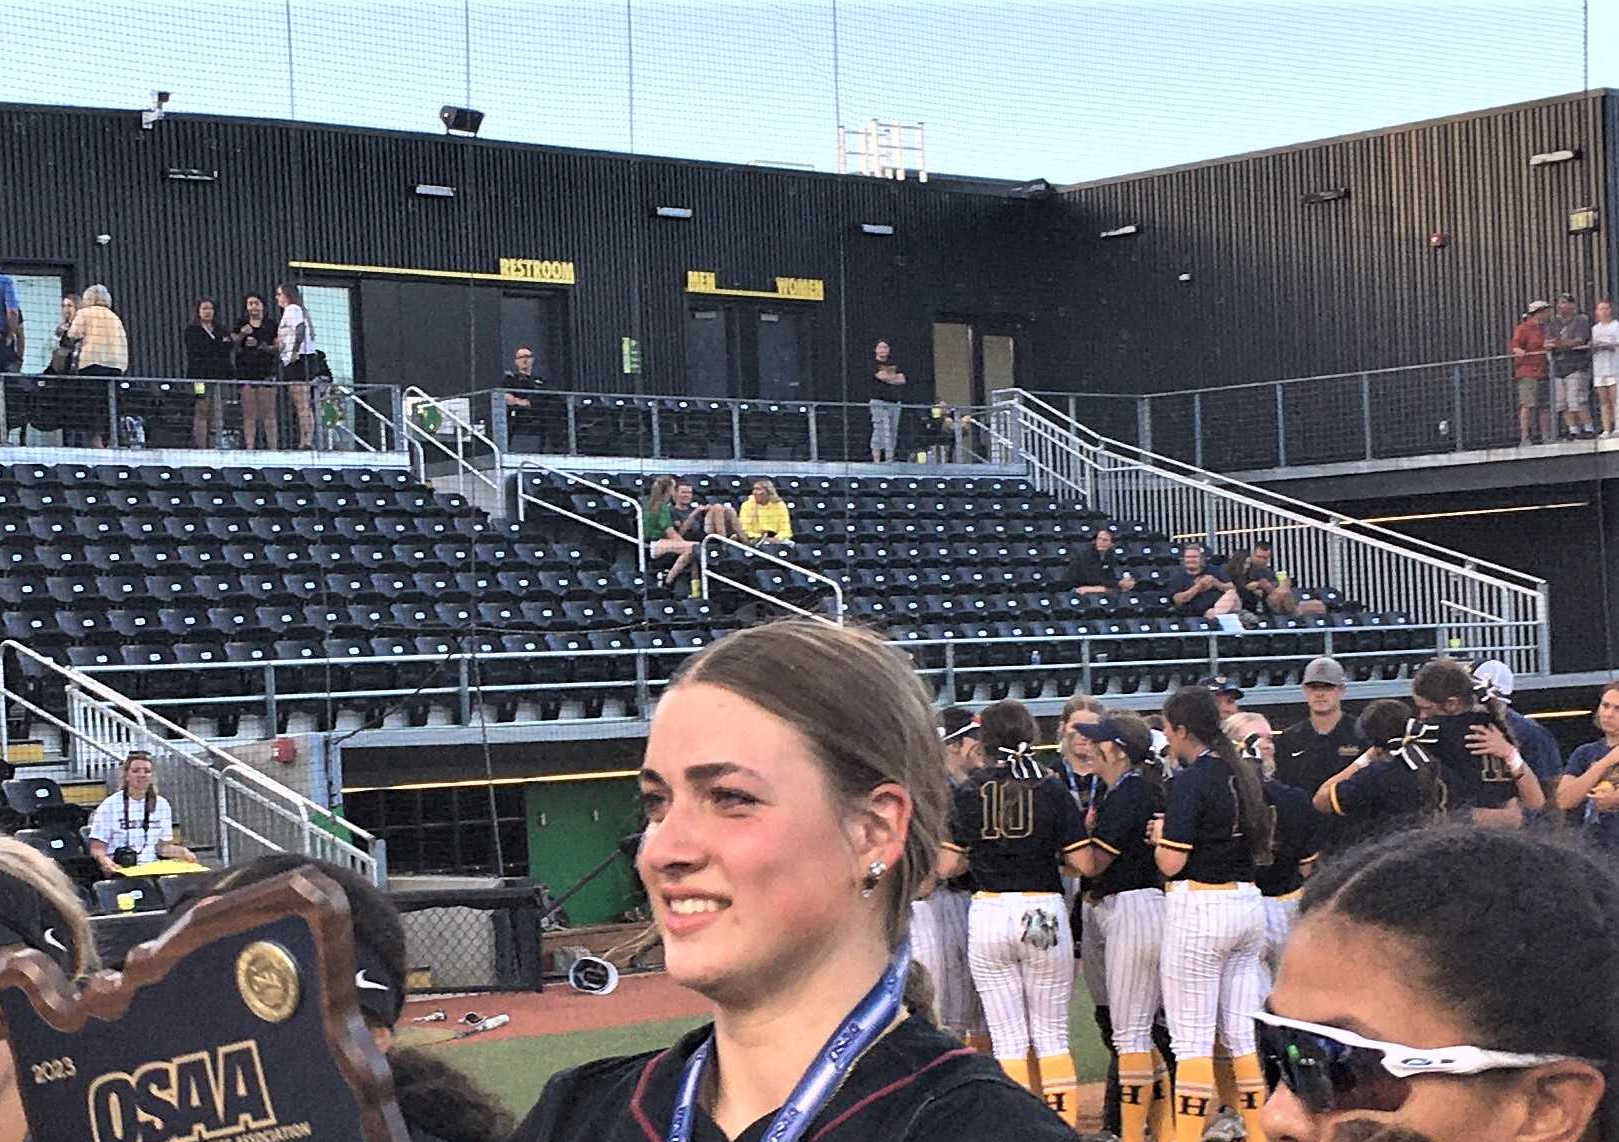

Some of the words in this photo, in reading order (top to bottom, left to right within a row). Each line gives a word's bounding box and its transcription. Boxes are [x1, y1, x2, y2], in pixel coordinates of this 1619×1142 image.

[500, 258, 574, 281] RESTROOM
[687, 270, 715, 291] MEN
[776, 277, 824, 298] WOMEN
[981, 781, 1033, 840] 10
[31, 1056, 77, 1084] 2023
[1179, 1094, 1209, 1117] H
